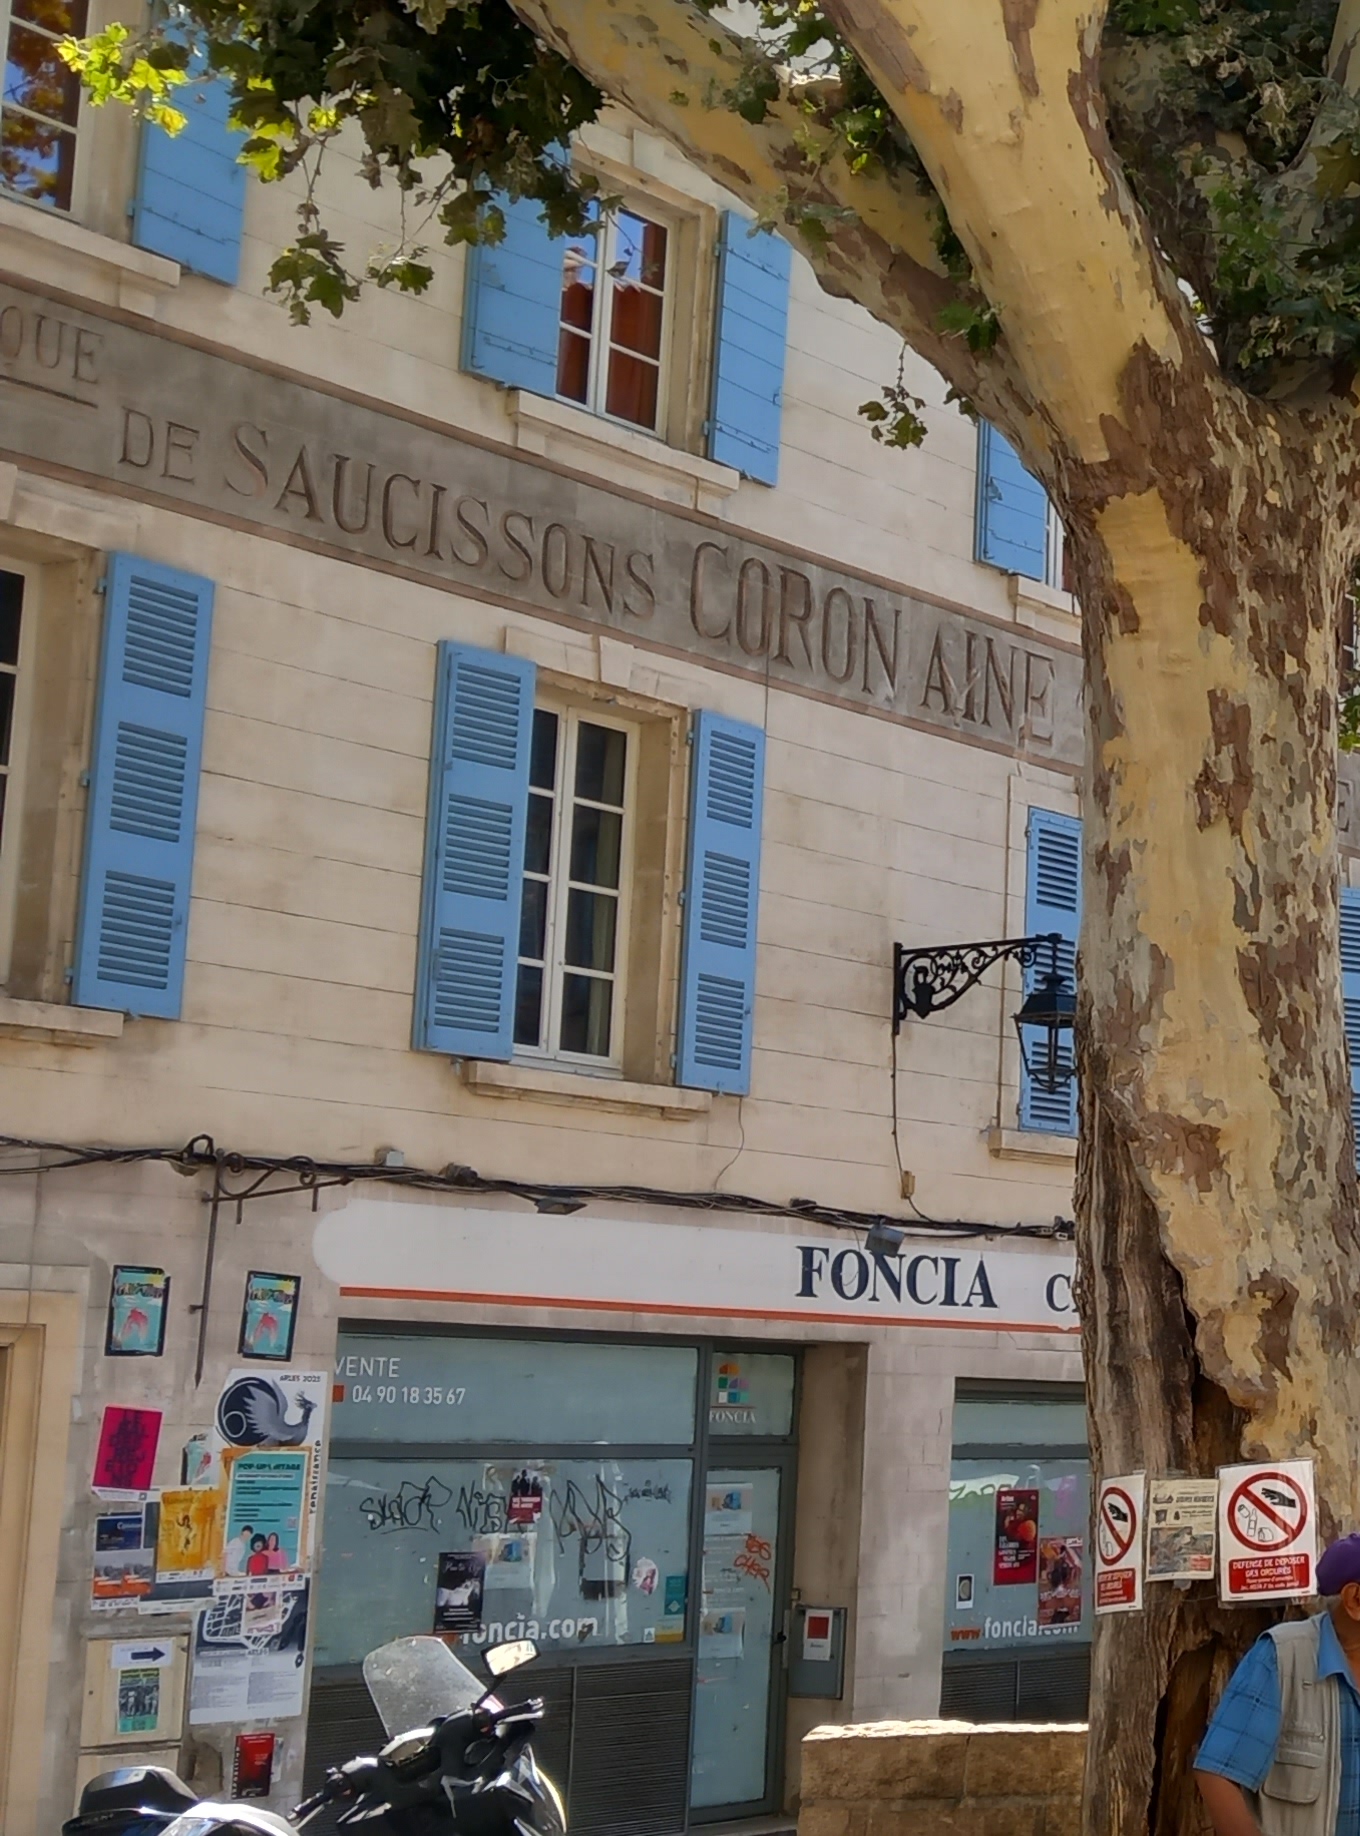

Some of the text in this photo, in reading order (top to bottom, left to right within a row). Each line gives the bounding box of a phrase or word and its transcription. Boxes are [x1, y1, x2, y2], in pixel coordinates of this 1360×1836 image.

[118, 406, 200, 483] DE
[224, 420, 656, 620] SAUCISSONS
[690, 541, 902, 701] CORON
[795, 1245, 999, 1309] FONCIA
[335, 1356, 401, 1378] VENTE
[352, 1385, 466, 1405] 04 90 18 35 67
[708, 1409, 757, 1425] FONCIA
